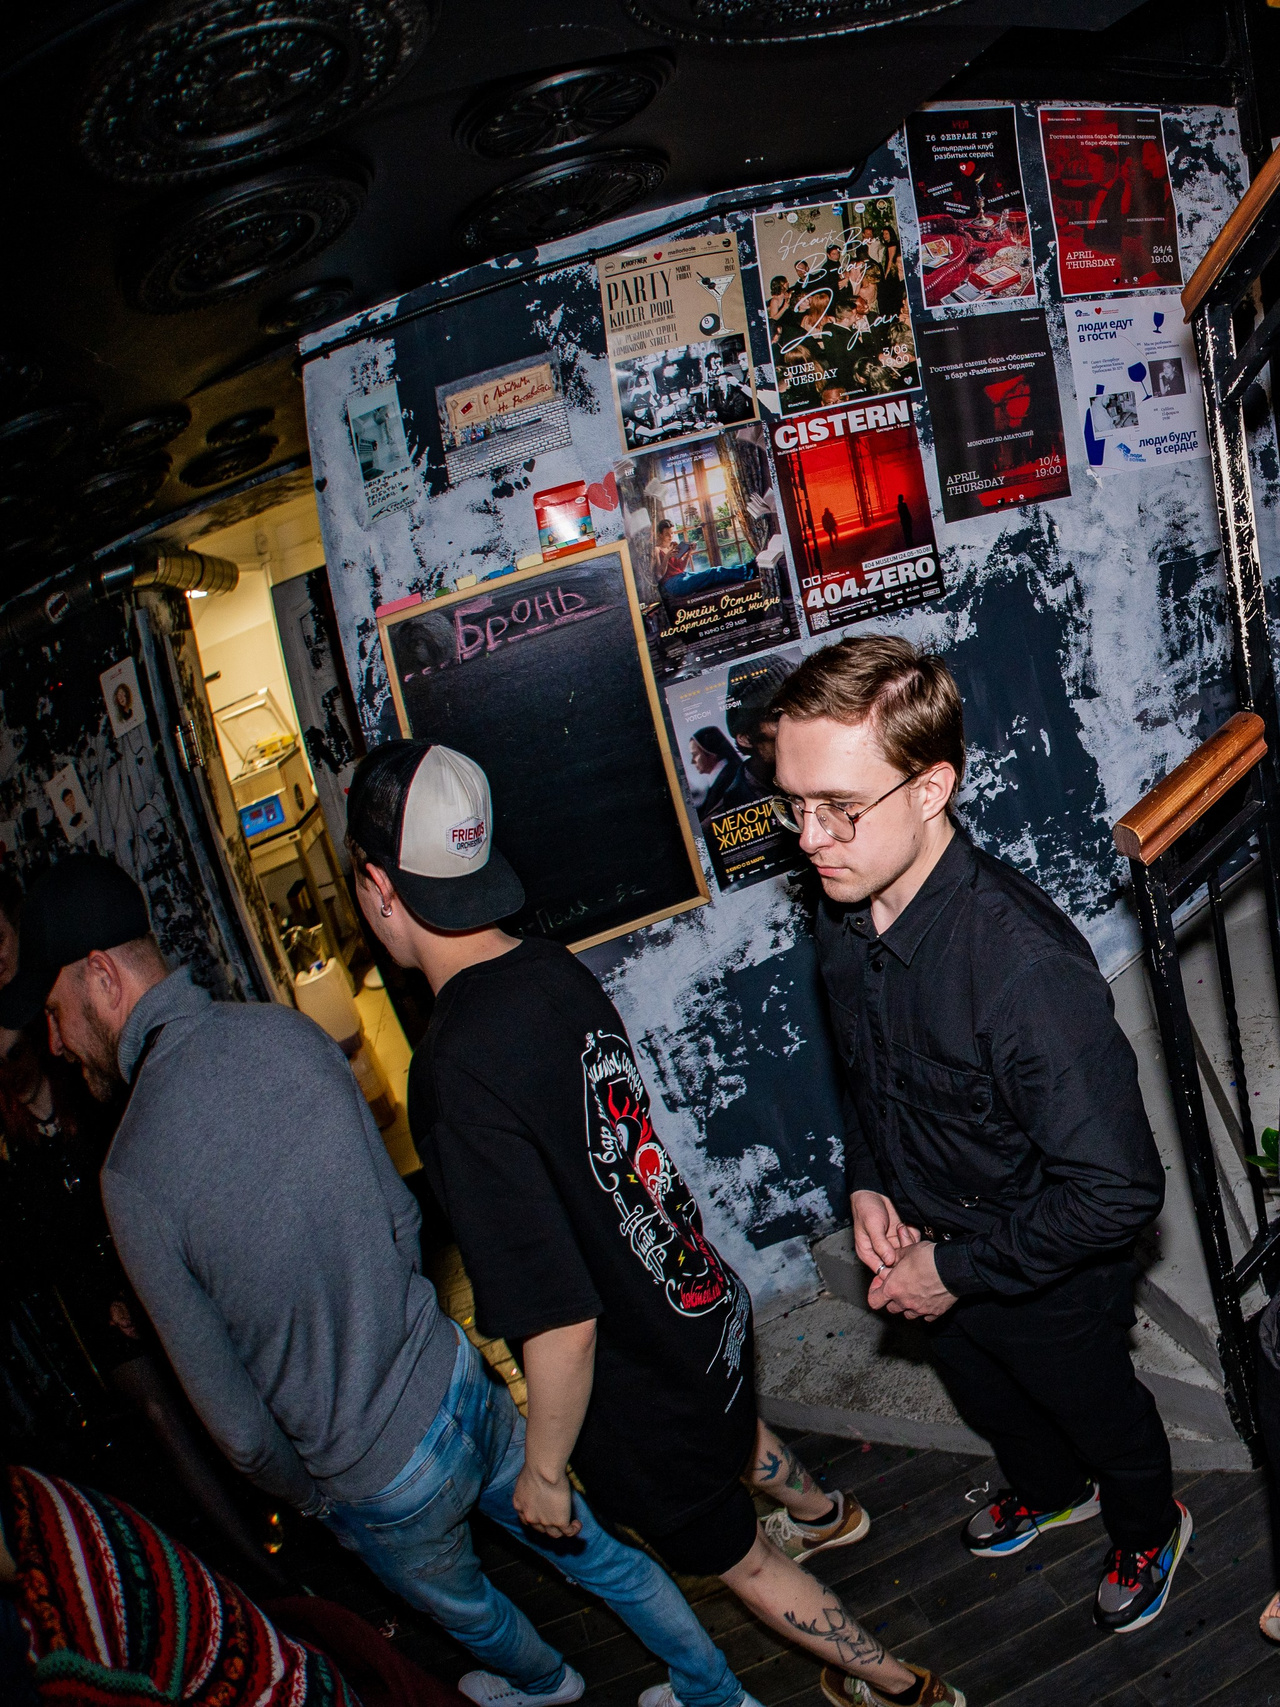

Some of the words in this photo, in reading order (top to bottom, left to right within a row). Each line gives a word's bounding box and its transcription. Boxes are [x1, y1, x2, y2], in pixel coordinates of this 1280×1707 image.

[940, 132, 978, 141] ФЕВРАЛЯ
[932, 144, 977, 153] бильярдный
[977, 142, 994, 151] клуб
[934, 152, 968, 161] разбитых
[969, 151, 995, 159] сердец
[1066, 250, 1095, 260] APRIL
[1153, 245, 1173, 254] 24/4
[1066, 258, 1116, 270] THURSDAY
[1151, 255, 1174, 264] 19:00
[676, 264, 691, 273] MARCH
[796, 253, 871, 288] B-day
[606, 268, 672, 311] PARTY
[609, 306, 646, 329] KILLER
[650, 299, 676, 318] POOL
[1077, 321, 1108, 333] люди
[1110, 318, 1134, 330] едут
[1079, 335, 1085, 343] в
[1087, 330, 1117, 341] гости
[882, 344, 908, 358] 3/06
[881, 355, 910, 369] 19:00
[929, 363, 963, 374] Гостевая
[964, 360, 987, 369] смена
[988, 357, 1005, 365] бара
[1005, 351, 1047, 363] «Обормоты»
[784, 362, 815, 377] JUNE
[951, 371, 968, 380] баре
[969, 366, 1006, 376] «Разбитых
[1007, 362, 1036, 373] Сердец»
[784, 368, 839, 388] TUESDAY
[774, 399, 910, 450] CISTERN
[1138, 435, 1168, 448] люди
[1169, 430, 1198, 443] будут
[805, 443, 817, 451] Space
[1155, 447, 1162, 455] в
[1163, 441, 1199, 454] сердце
[1039, 454, 1061, 467] 10/4
[946, 470, 980, 485] APRIL
[1035, 465, 1062, 478] 19:00
[947, 476, 1005, 496] THURSDAY
[875, 555, 898, 566] MUSEUM
[806, 557, 936, 609] 404.ZERO
[691, 589, 725, 603] романтической
[725, 584, 745, 593] комедии
[675, 603, 718, 625] Джейн
[720, 591, 762, 609] Остин
[660, 614, 721, 638] испортила
[723, 607, 746, 618] мне
[748, 596, 780, 612] жизнь
[725, 621, 734, 629] 29
[685, 711, 711, 723] УОТСОН
[452, 822, 484, 842] FRIENDS
[716, 818, 771, 851] ЖИЗНИ
